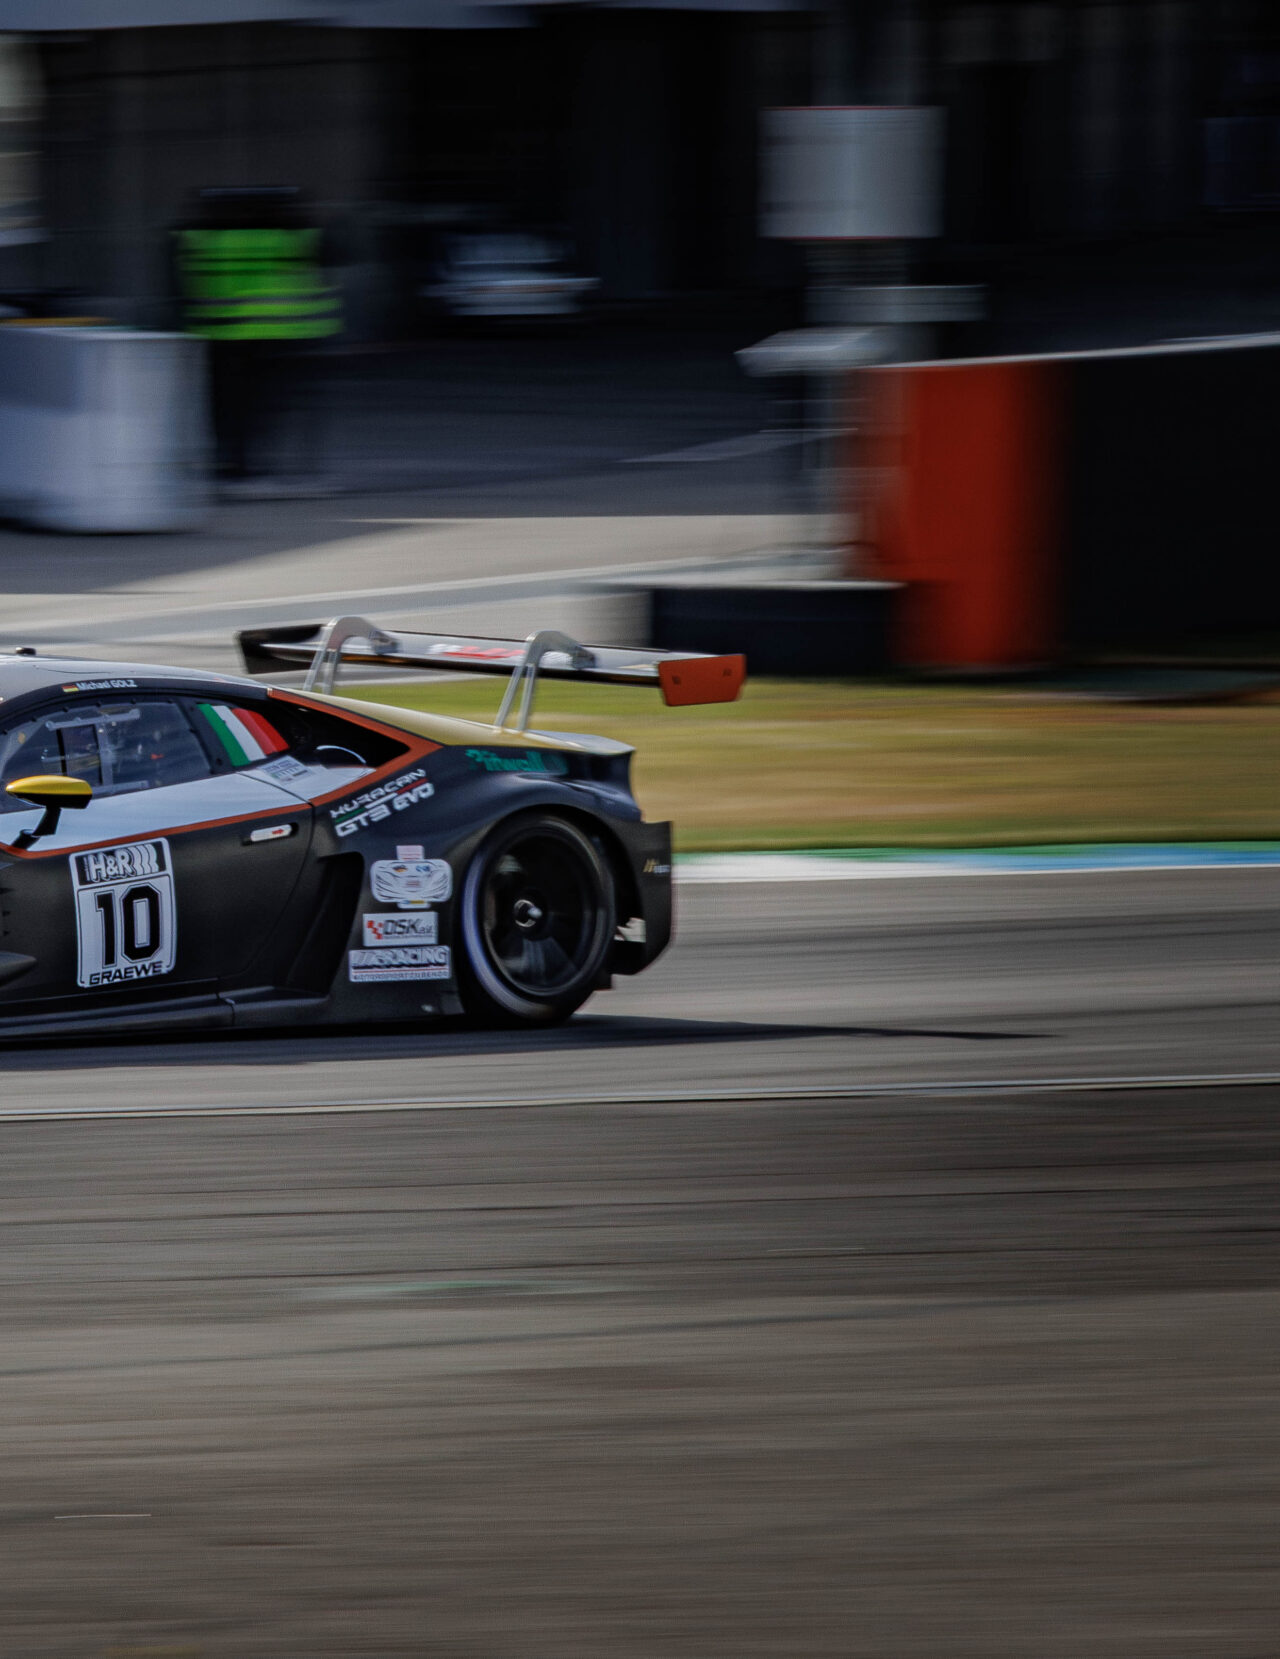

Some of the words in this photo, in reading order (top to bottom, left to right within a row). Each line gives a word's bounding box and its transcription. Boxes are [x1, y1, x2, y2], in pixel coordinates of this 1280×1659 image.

[76, 681, 110, 691] Michael
[335, 803, 391, 837] GT3
[84, 848, 137, 882] H&R
[95, 882, 162, 970] 10
[384, 919, 420, 935] DSK
[89, 960, 164, 985] GRAEWE
